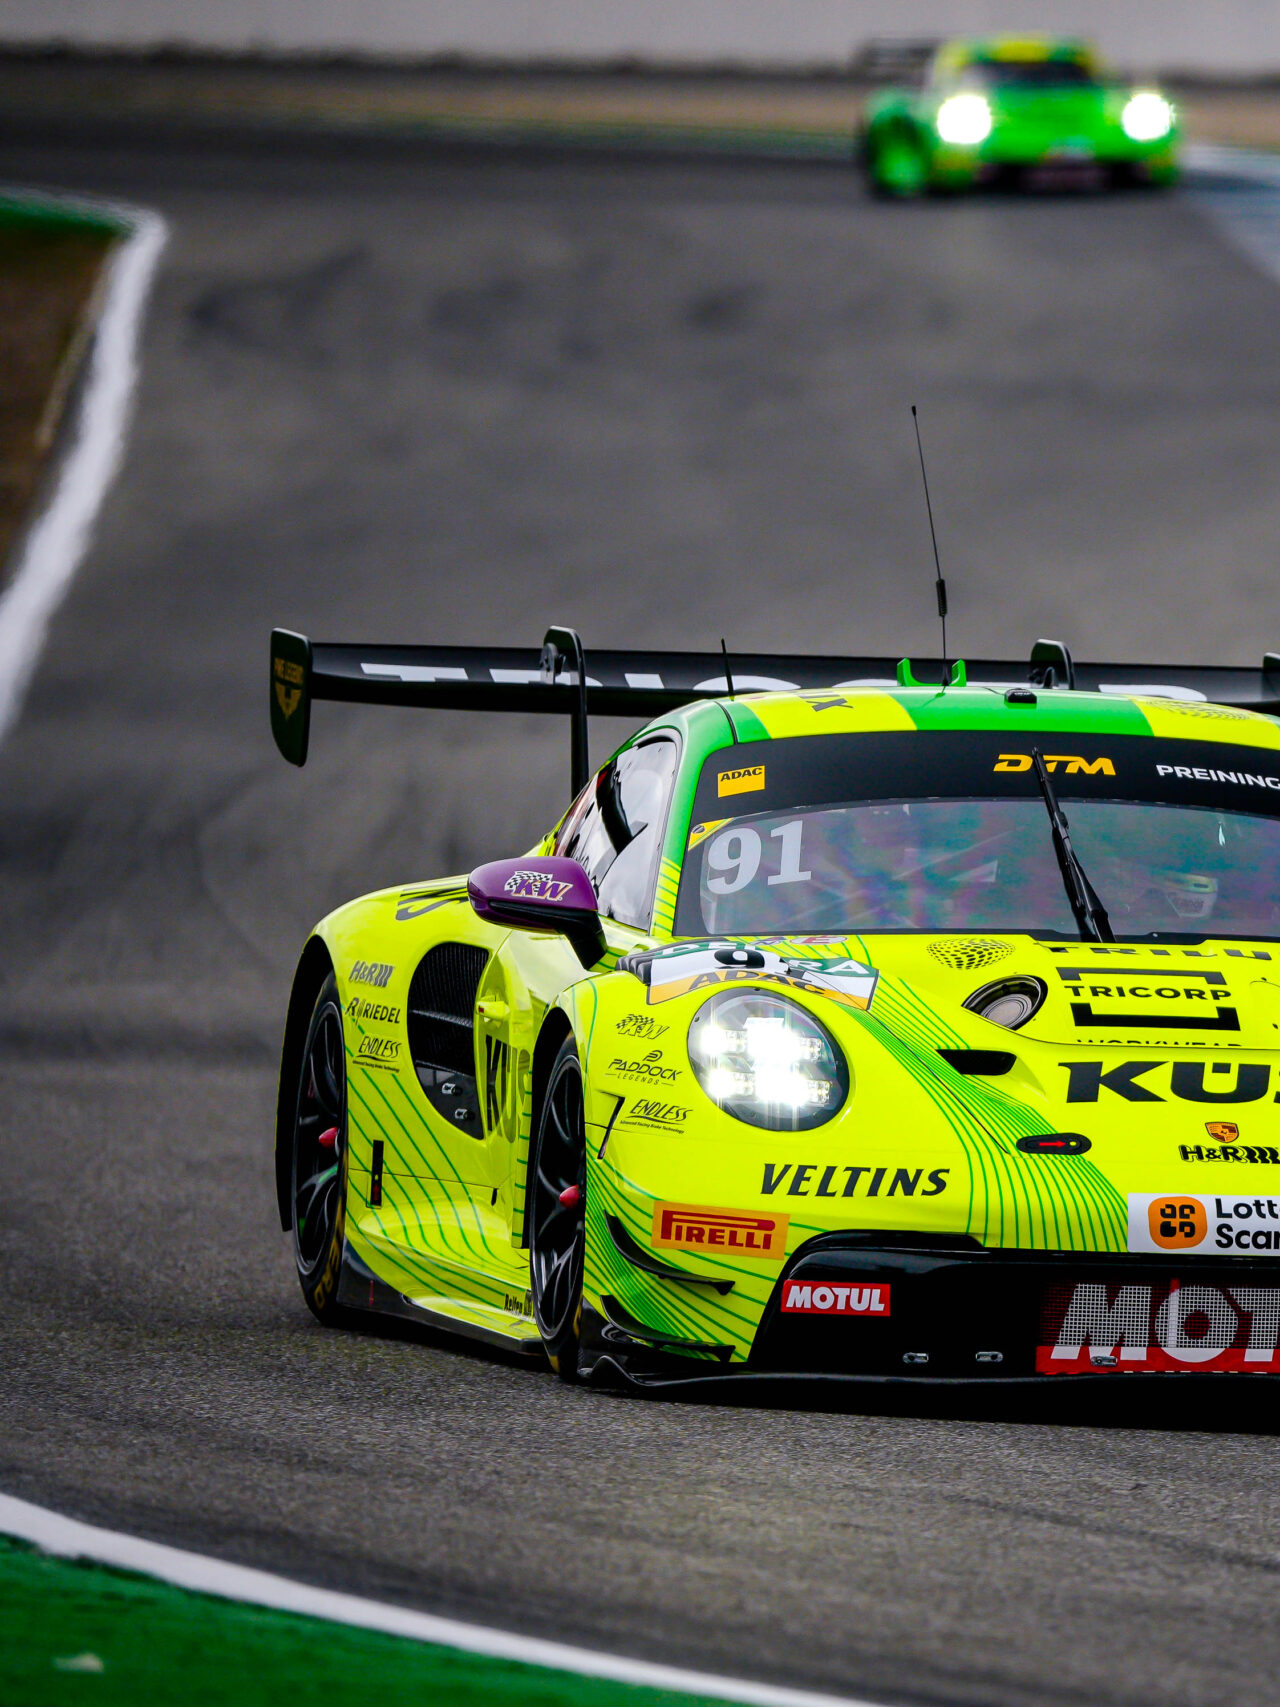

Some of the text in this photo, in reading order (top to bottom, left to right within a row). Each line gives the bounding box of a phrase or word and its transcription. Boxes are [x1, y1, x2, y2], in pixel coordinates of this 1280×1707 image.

[720, 767, 764, 782] ADAC
[993, 754, 1117, 776] DTM
[706, 820, 812, 895] 91
[512, 879, 573, 902] KW
[660, 942, 870, 975] DERA
[688, 970, 826, 995] ADAC
[1064, 984, 1232, 1002] TRICORP
[364, 1002, 402, 1025] RIEDEL
[358, 1035, 403, 1060] ENDLESS
[607, 1058, 684, 1082] PADDOCK
[617, 1071, 661, 1086] LEGENDS
[629, 1098, 694, 1123] ENDLESS
[760, 1162, 951, 1198] VELTINS
[660, 1209, 776, 1251] PIRELLI
[785, 1285, 885, 1312] MOTUL
